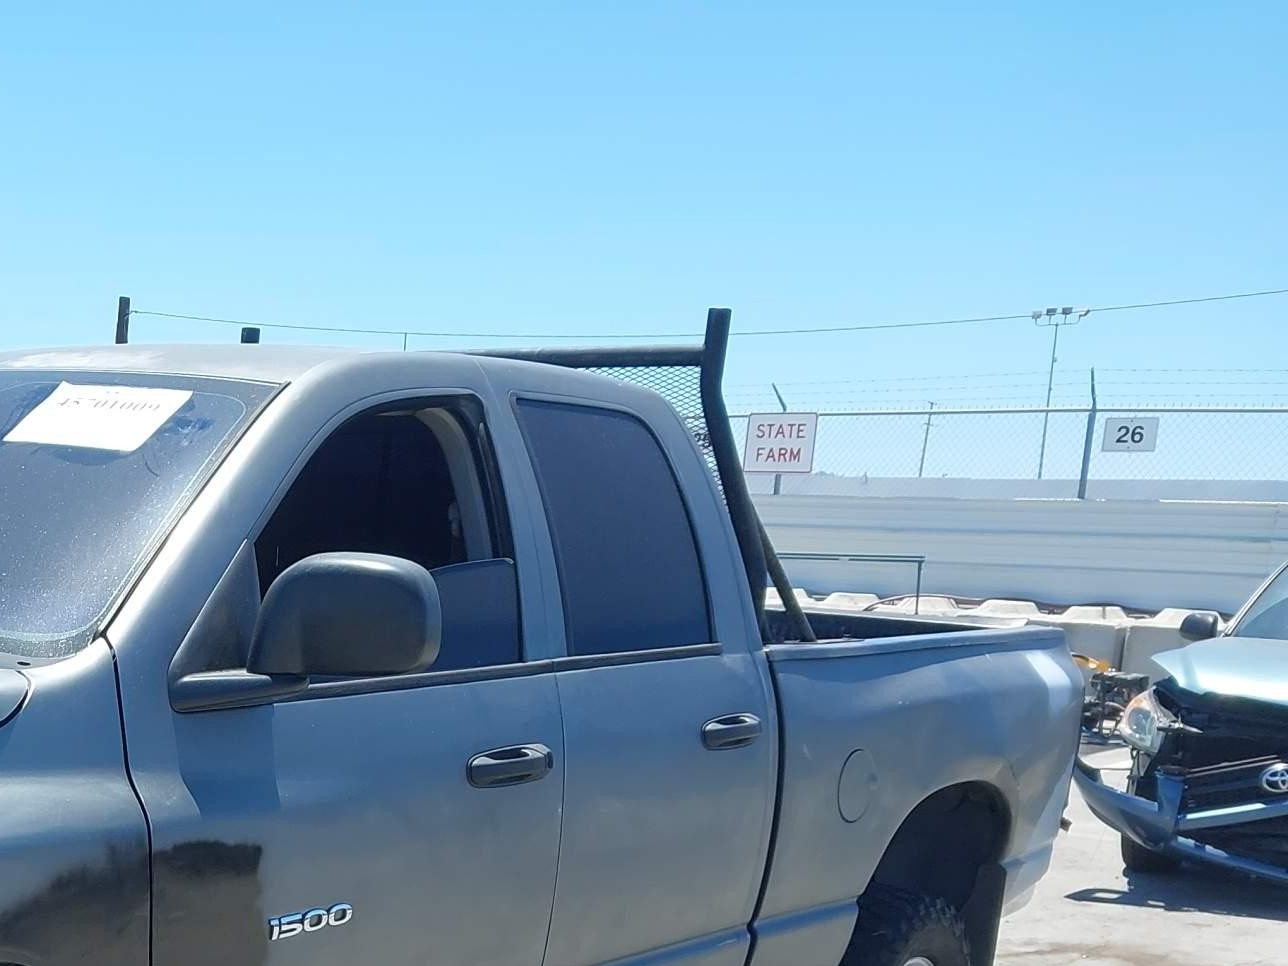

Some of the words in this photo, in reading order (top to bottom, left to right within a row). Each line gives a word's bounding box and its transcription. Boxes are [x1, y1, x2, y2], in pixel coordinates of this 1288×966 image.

[756, 423, 806, 439] STATE
[1115, 426, 1144, 444] 26
[755, 447, 801, 463] FARM
[269, 902, 353, 940] 1500
